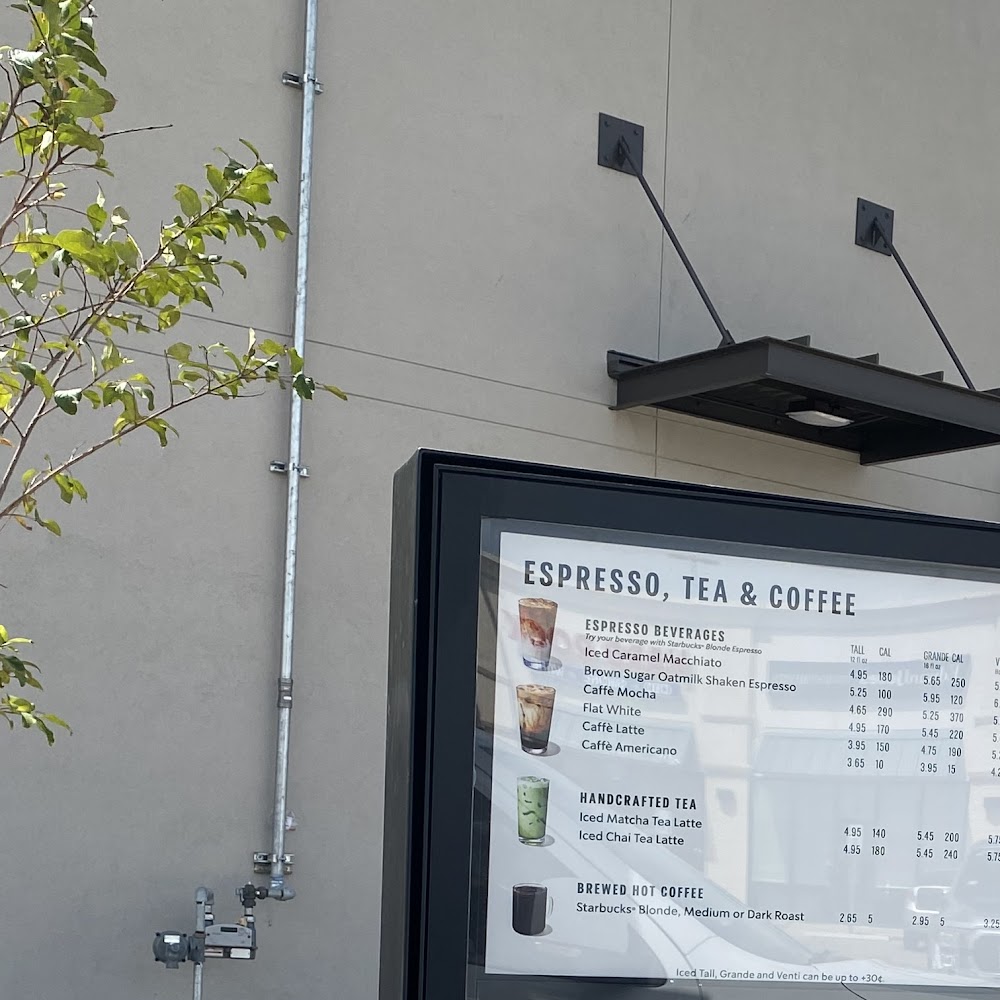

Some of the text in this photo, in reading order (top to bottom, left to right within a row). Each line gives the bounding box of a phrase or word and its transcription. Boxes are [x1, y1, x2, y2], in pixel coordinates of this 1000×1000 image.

[524, 560, 856, 616] ESPRESSO, TEA & COFFEE
[585, 618, 725, 642] ESPRESSO BEVERAGES
[585, 646, 722, 668] Iced Caramel Macchiato
[584, 665, 797, 692] Brown Sugar Oatmilk Shaken Espresso
[849, 669, 893, 682] 4.95 180
[923, 675, 966, 688] 5.65 250
[583, 684, 656, 700] Caffè Mocha
[583, 702, 642, 717] Flat White
[582, 721, 645, 736] Caffè Latte
[581, 739, 677, 756] Caffè Americano
[580, 792, 696, 810] HANDCRAFTED TEA
[579, 812, 702, 829] Iced Matcha Tea Latte
[579, 830, 684, 846] Iced Chai Tea Latte
[577, 882, 703, 899] BREWED HOT COFFEE
[638, 904, 681, 917] Blonde,
[684, 906, 730, 918] Medium
[732, 911, 745, 919] or
[747, 909, 772, 920] Dark
[774, 910, 804, 922] Roast
